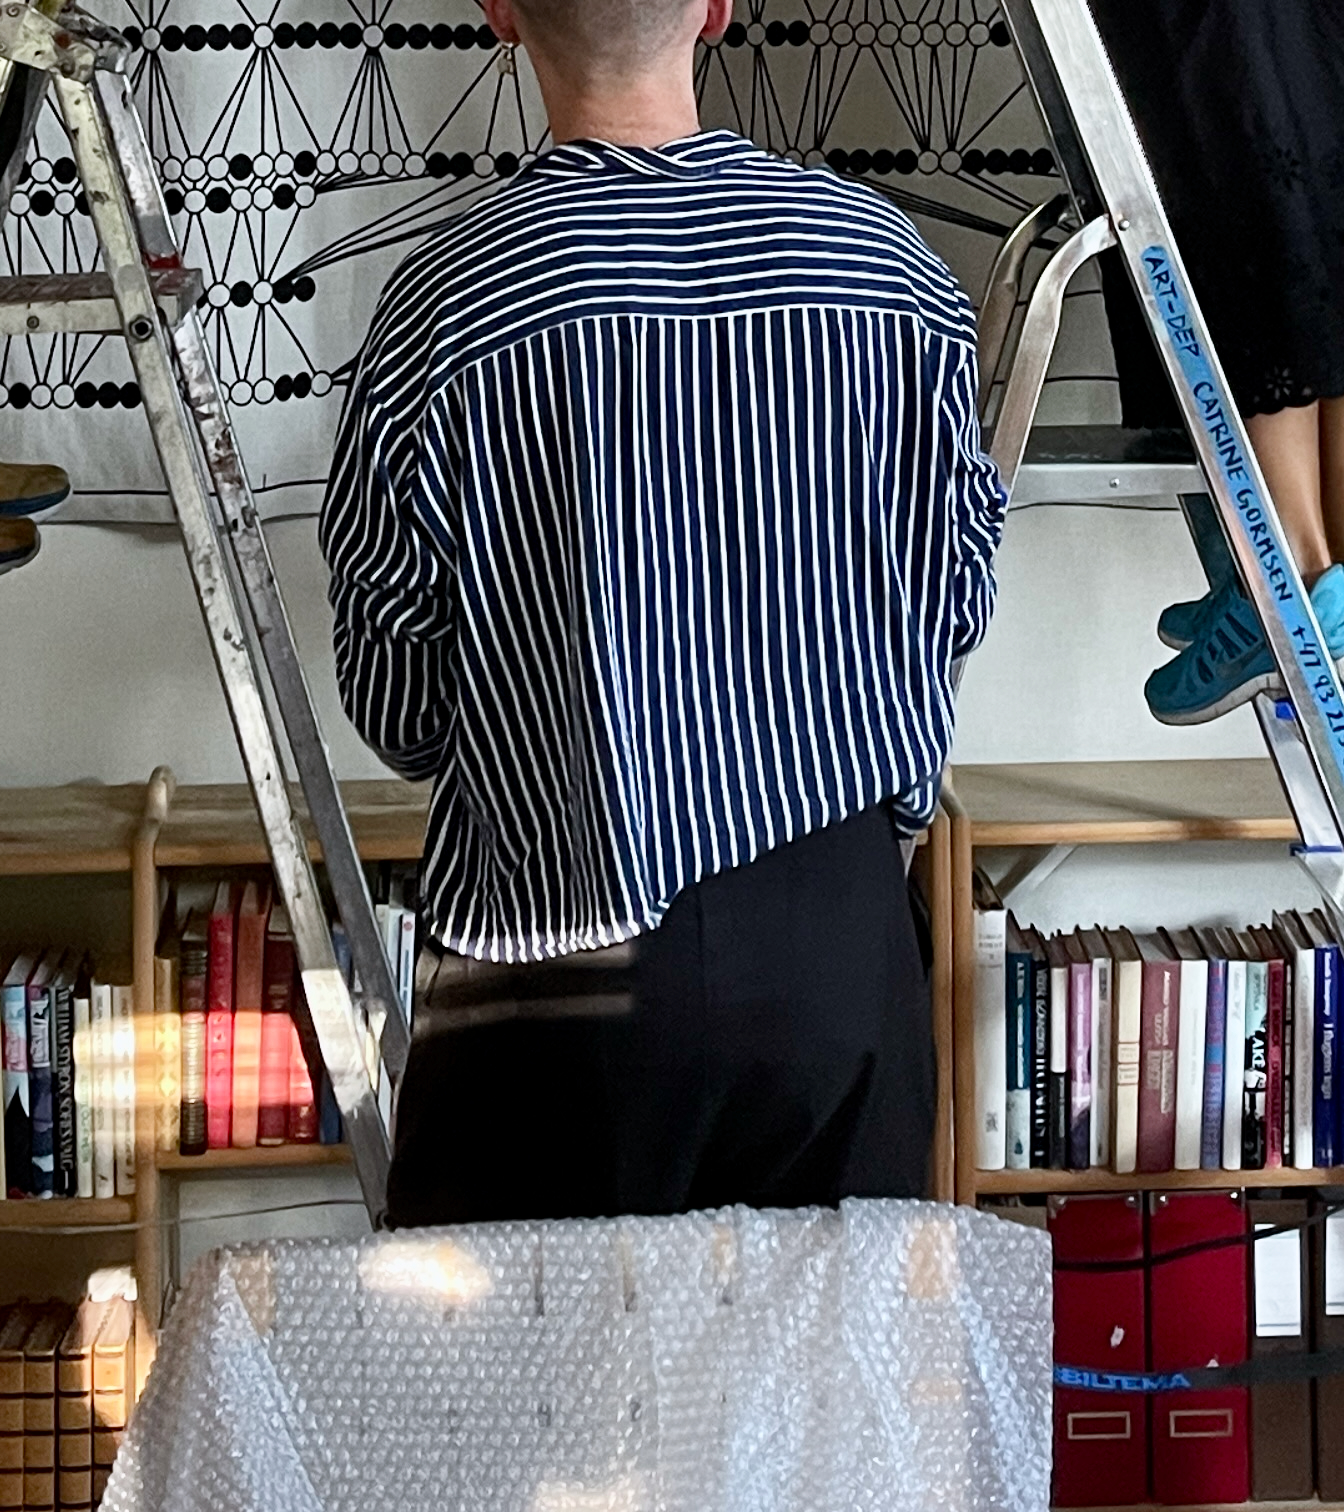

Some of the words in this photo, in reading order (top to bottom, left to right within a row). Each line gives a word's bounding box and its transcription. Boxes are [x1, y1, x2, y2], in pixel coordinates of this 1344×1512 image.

[1144, 257, 1200, 357] ART-DEP
[1193, 381, 1250, 482] CATRINE
[1236, 488, 1293, 602] GORMSEN
[1292, 625, 1323, 668] +47
[1314, 674, 1336, 704] 93
[1060, 1367, 1192, 1391] BILTEMA
